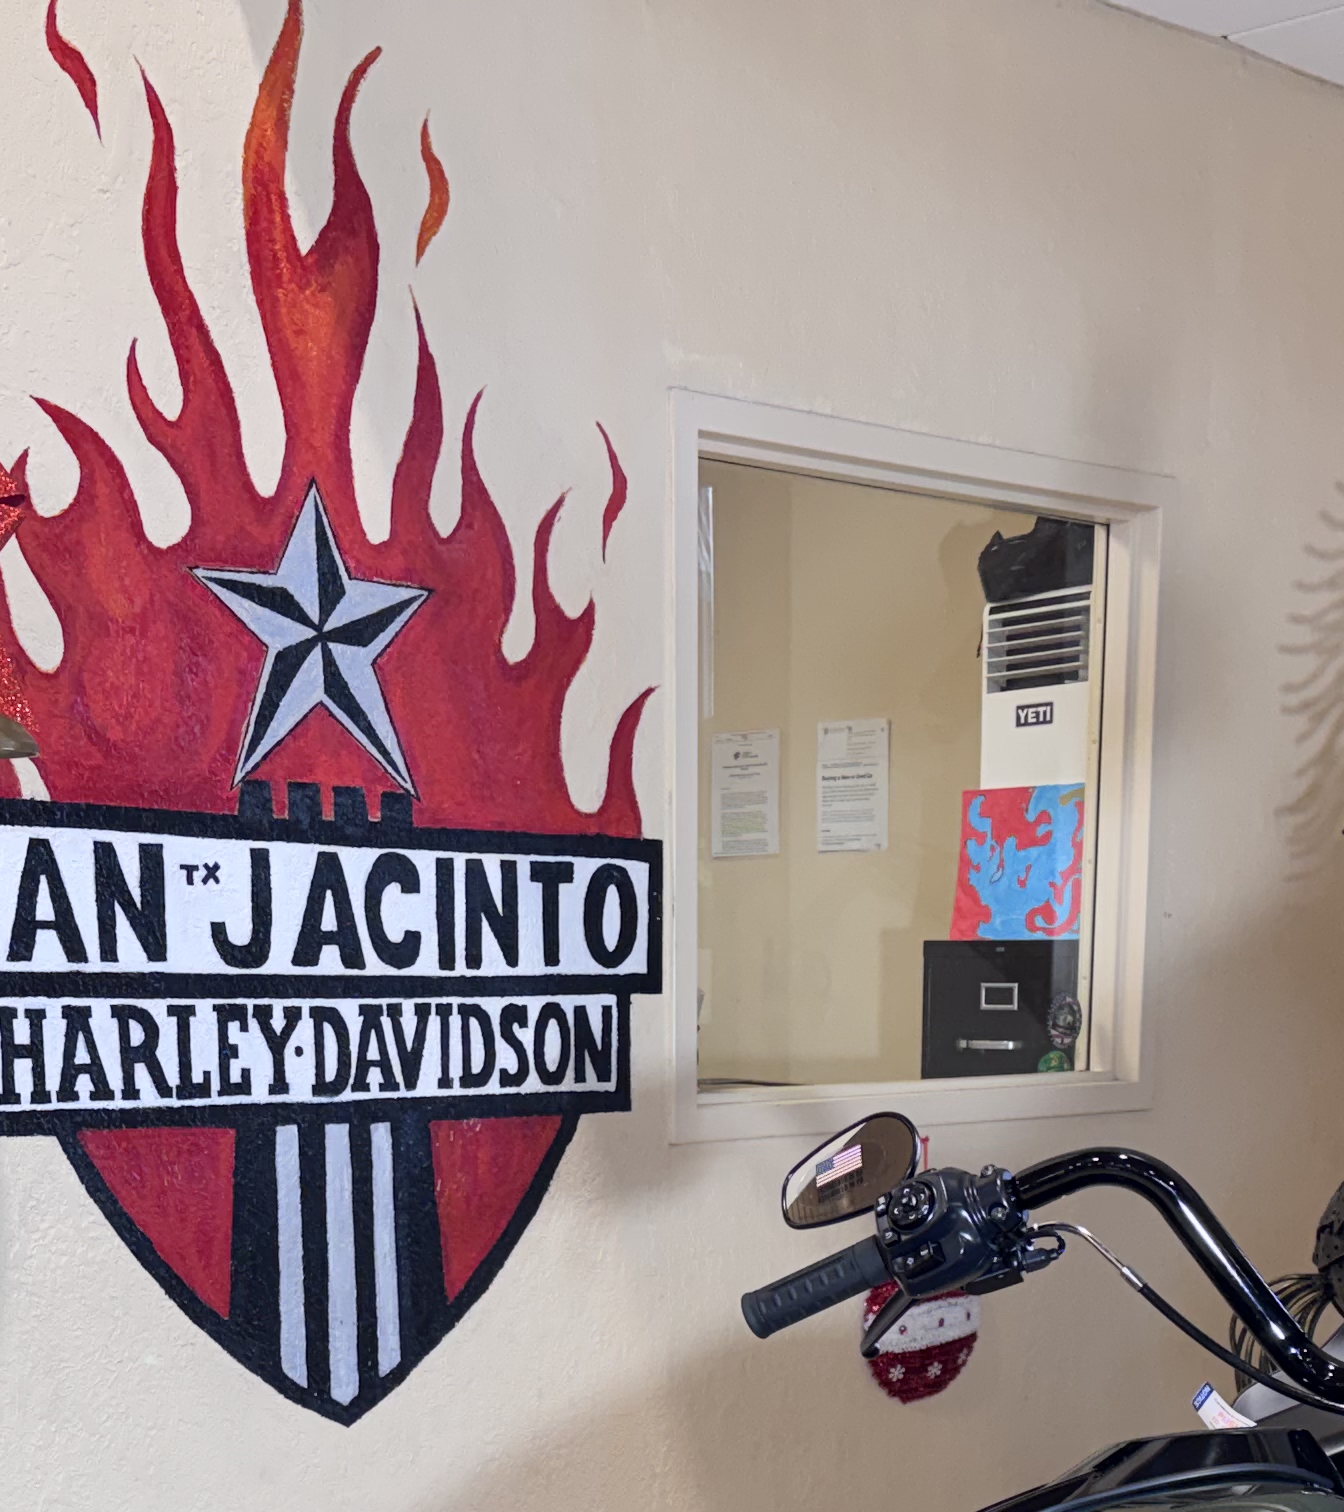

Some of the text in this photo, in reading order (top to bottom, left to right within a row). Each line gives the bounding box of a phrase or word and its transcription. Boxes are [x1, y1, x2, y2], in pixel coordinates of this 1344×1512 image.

[1017, 706, 1051, 724] YETI
[180, 861, 221, 886] TX
[210, 848, 639, 970] JACINTO
